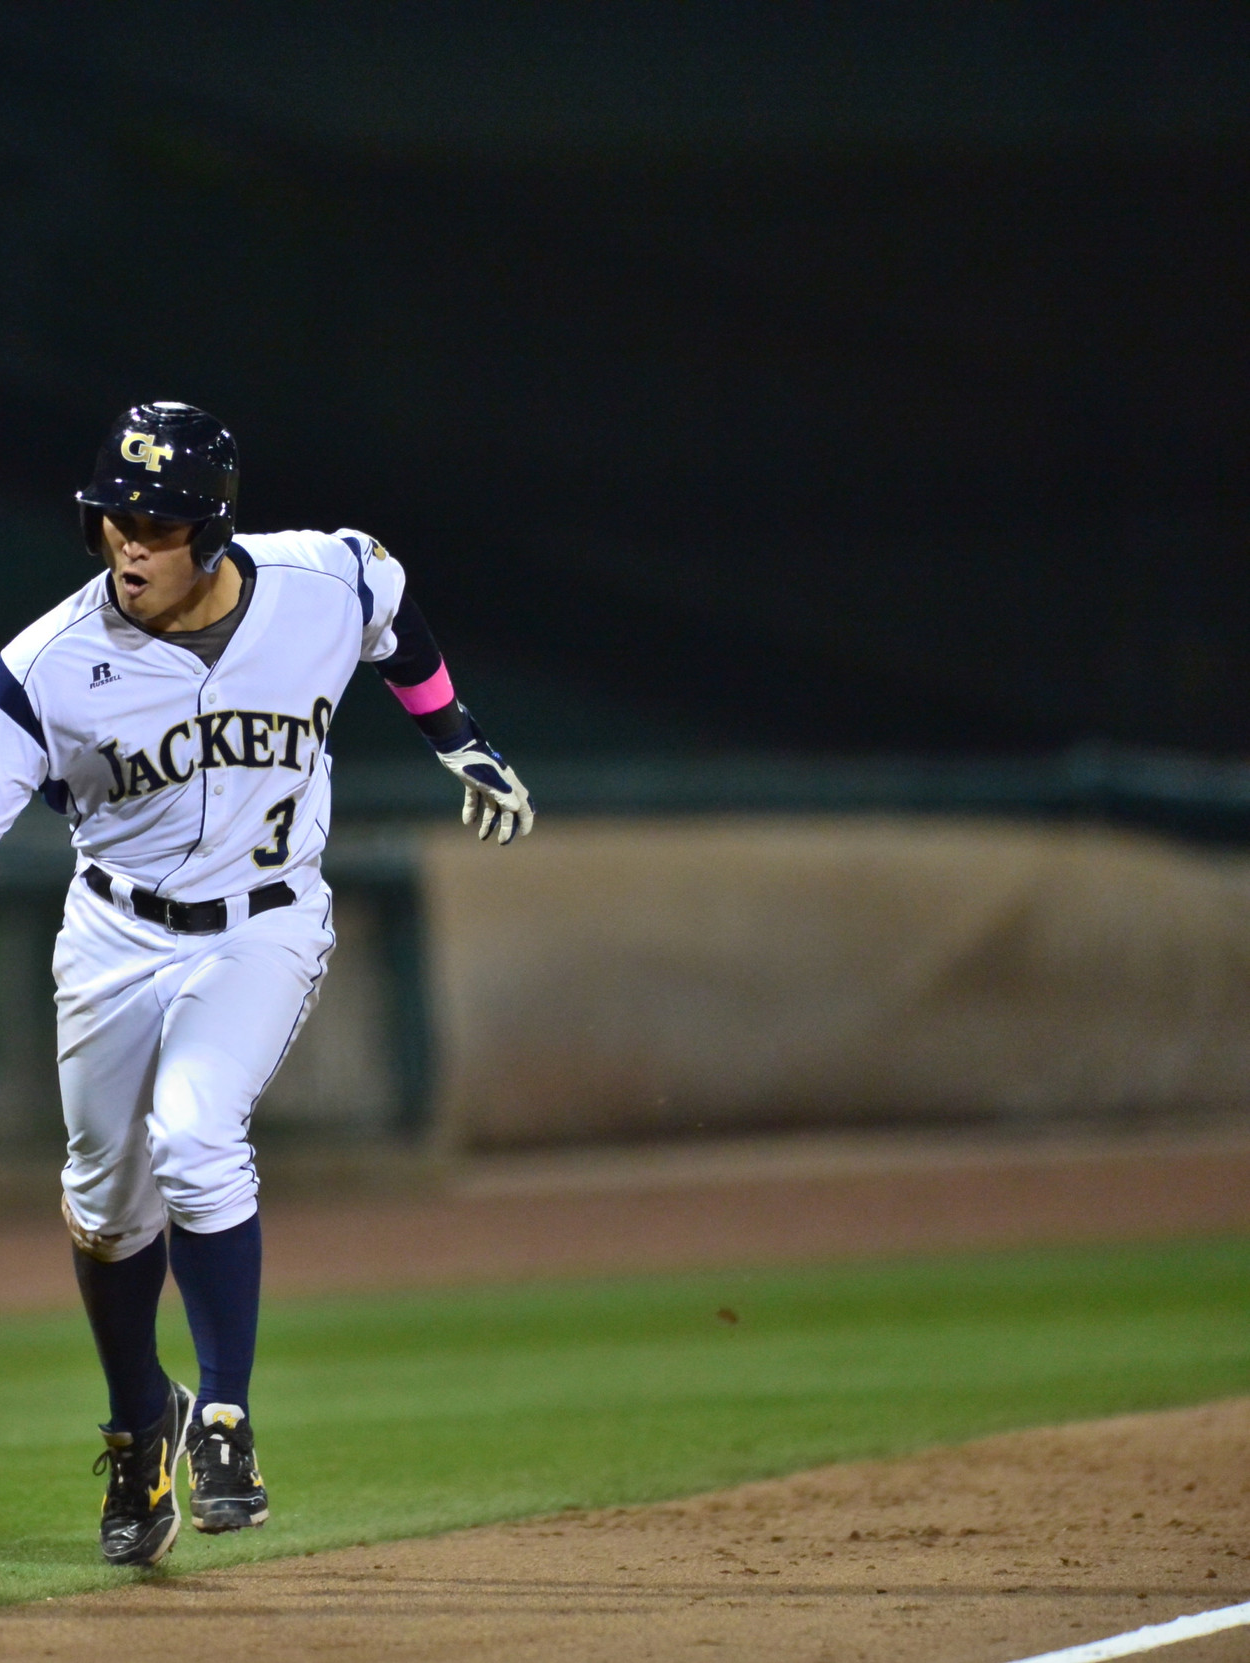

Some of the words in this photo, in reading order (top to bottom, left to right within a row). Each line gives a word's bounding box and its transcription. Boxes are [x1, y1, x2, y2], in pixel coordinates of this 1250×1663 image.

[121, 433, 174, 472] GT
[129, 491, 140, 501] 3
[92, 662, 111, 682] R
[90, 675, 122, 690] RUSSELL
[251, 795, 296, 870] 3
